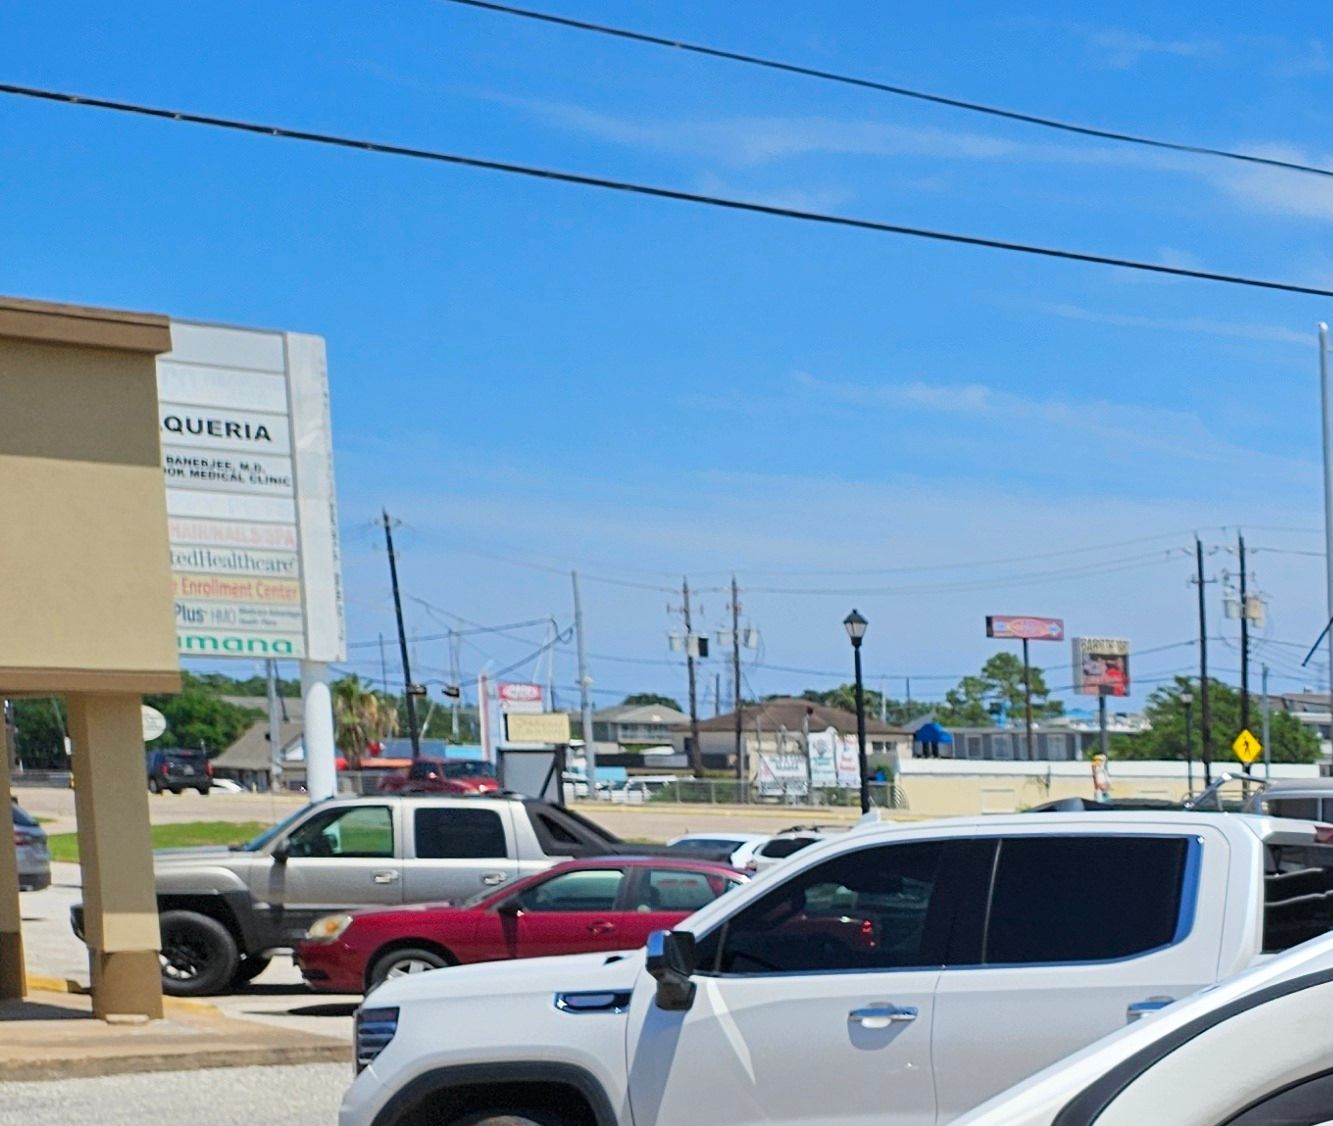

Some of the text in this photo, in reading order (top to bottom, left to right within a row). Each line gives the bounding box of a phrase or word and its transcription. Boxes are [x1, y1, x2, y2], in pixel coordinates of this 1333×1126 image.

[160, 414, 272, 443] QUERIA
[189, 468, 244, 483] MEDICAL
[249, 474, 292, 487] CLINIC
[181, 576, 252, 598] Enrollment
[255, 580, 298, 599] Center
